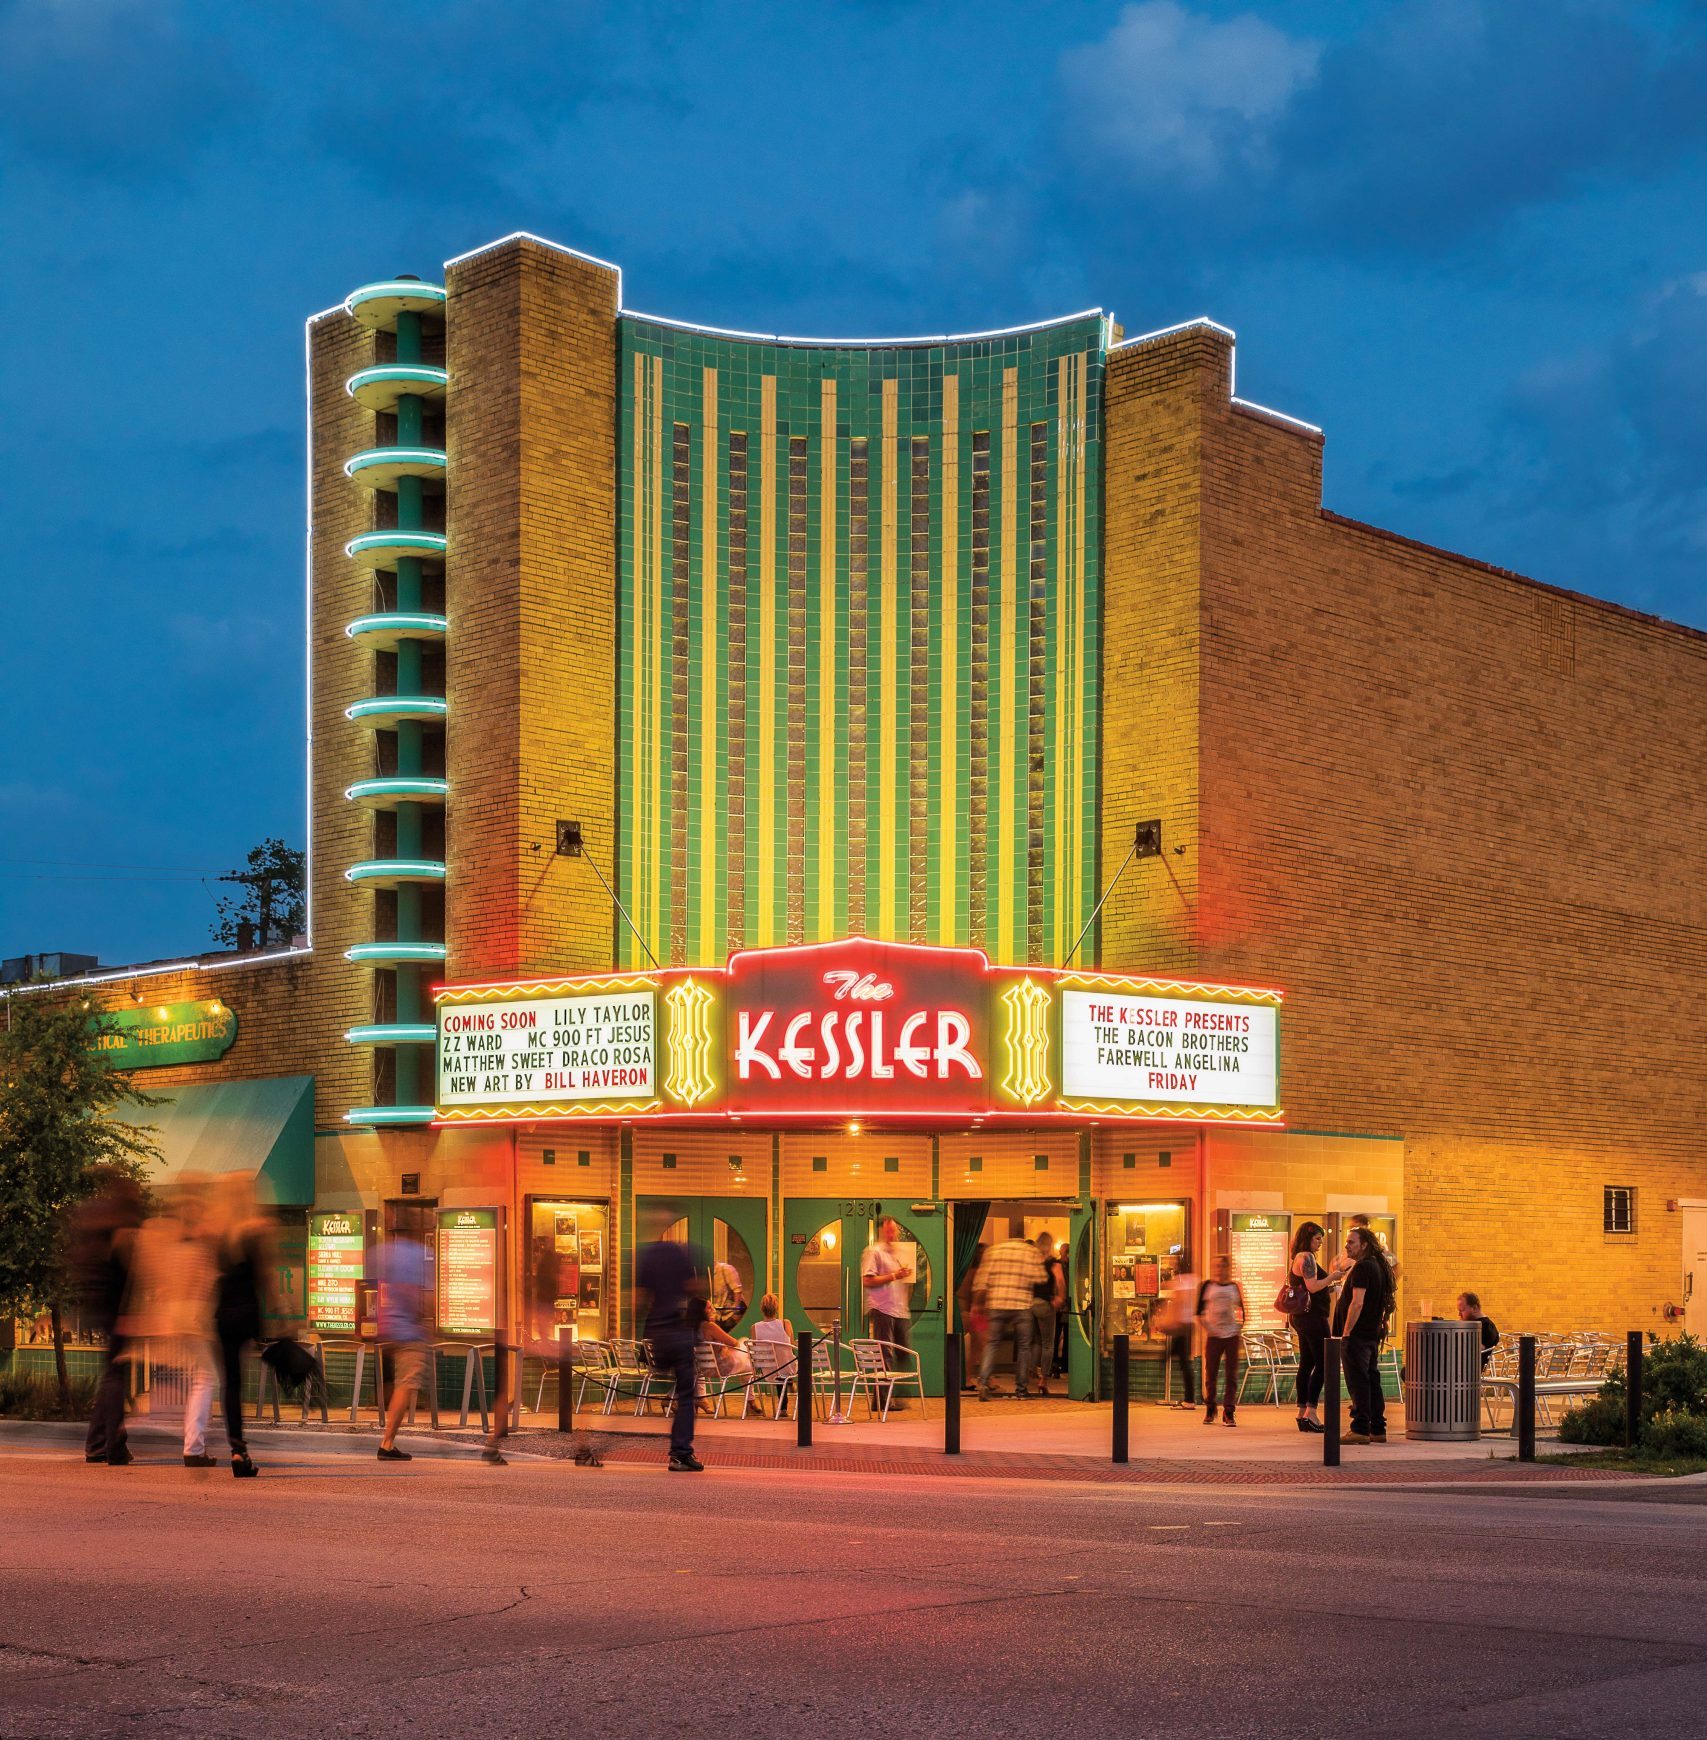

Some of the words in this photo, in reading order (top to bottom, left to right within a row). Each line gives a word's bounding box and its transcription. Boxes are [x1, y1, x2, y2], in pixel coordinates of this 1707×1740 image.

[822, 970, 894, 1000] The
[444, 1013, 494, 1033] COMING
[501, 1011, 536, 1029] SOON
[555, 1008, 586, 1026] LILY
[594, 1004, 650, 1023] TAYLOR
[1089, 1005, 1113, 1022] THE
[1120, 1008, 1177, 1027] KESSLER
[1185, 1012, 1249, 1032] PRESENTS
[137, 1020, 227, 1047] THERAPEUTICS
[467, 1034, 502, 1051] WARD
[528, 1032, 546, 1049] MC
[553, 1029, 580, 1047] 900
[586, 1028, 601, 1045] FT
[607, 1025, 650, 1044] JESUS
[734, 1010, 982, 1079] KESSLER
[1094, 1027, 1118, 1044] THE
[1128, 1029, 1173, 1047] BACON
[1182, 1033, 1248, 1052] BROTHERS
[444, 1054, 505, 1072] MATTHEW
[512, 1052, 553, 1070] SWEET
[563, 1049, 608, 1067] DRACO
[613, 1047, 651, 1065] ROSA
[1098, 1048, 1167, 1068] FAREWELL
[1175, 1053, 1240, 1072] ANGELINA
[451, 1077, 476, 1093] NEW
[484, 1075, 509, 1091] ART
[515, 1074, 532, 1090] BY
[545, 1072, 575, 1089] BILL
[583, 1068, 647, 1087] HAVERON
[1148, 1072, 1197, 1090] FRIDAY
